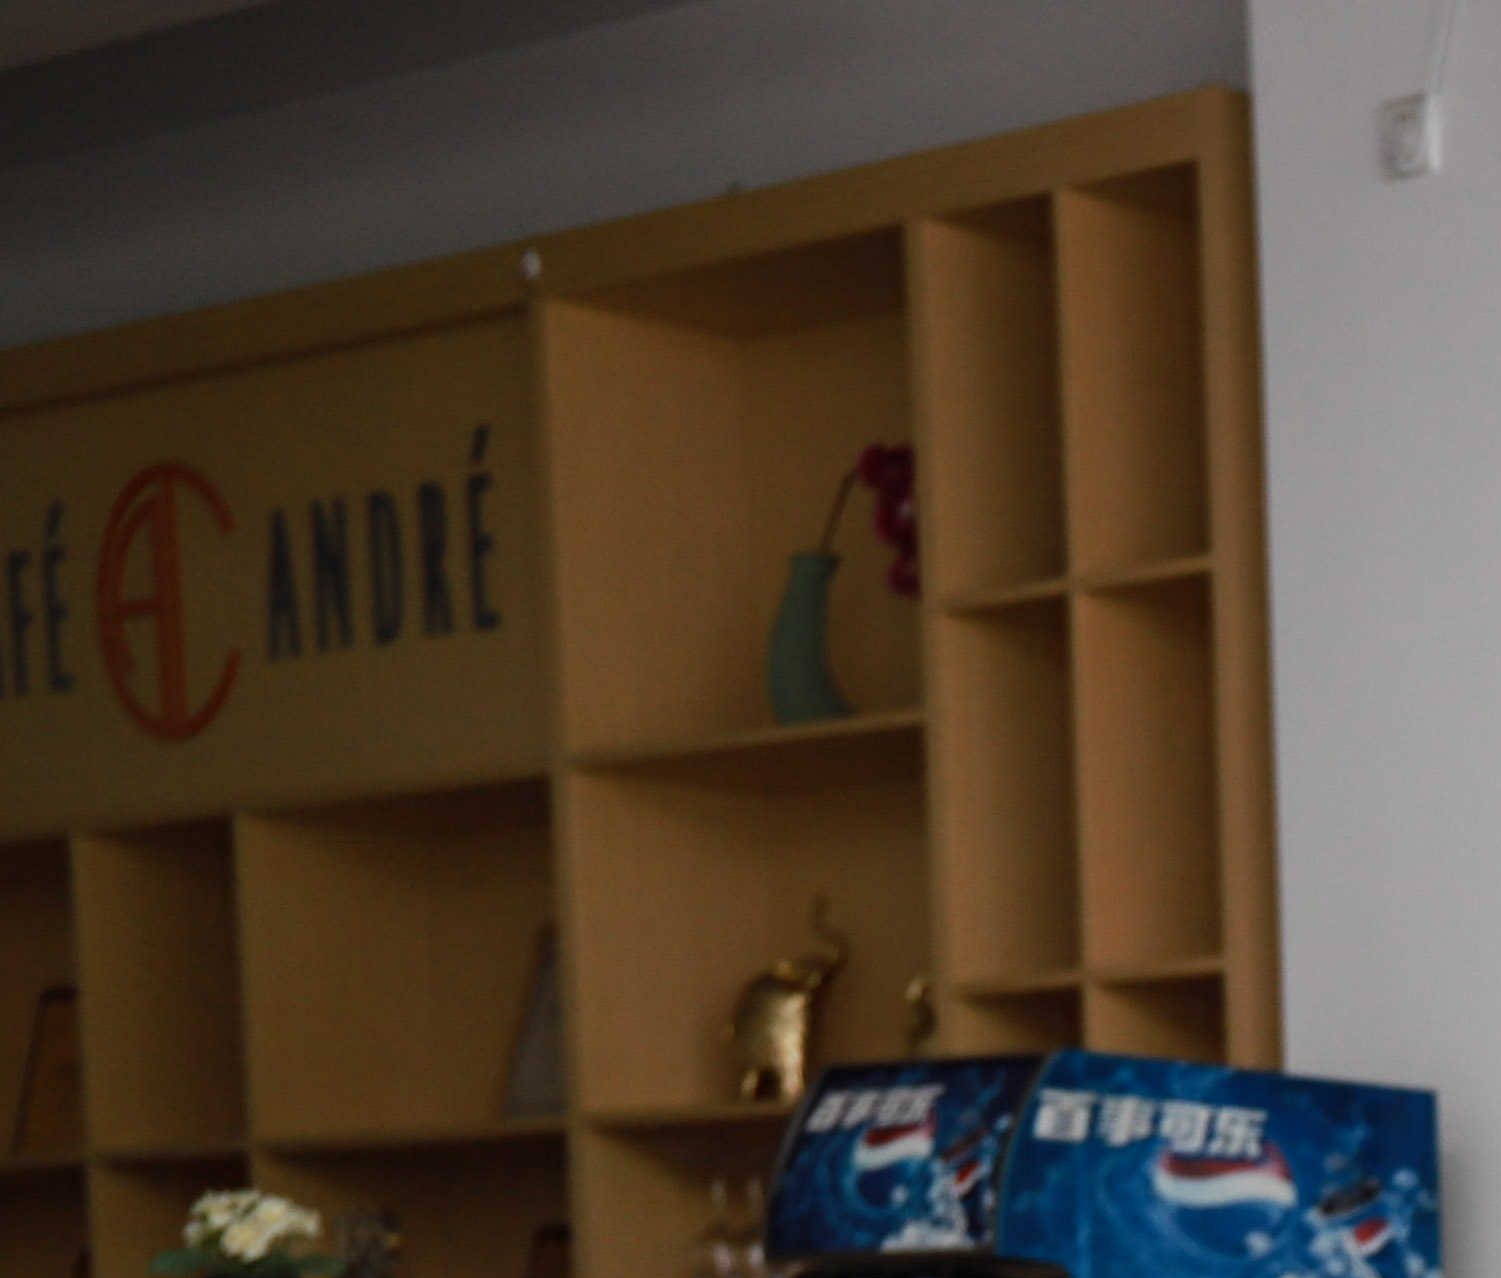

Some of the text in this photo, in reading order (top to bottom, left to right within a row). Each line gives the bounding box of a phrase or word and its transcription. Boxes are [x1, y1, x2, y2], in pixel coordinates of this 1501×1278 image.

[0, 500, 75, 699] FÉ
[266, 423, 502, 662] ANDRÉ
[1031, 1087, 1269, 1157] 百事可乐
